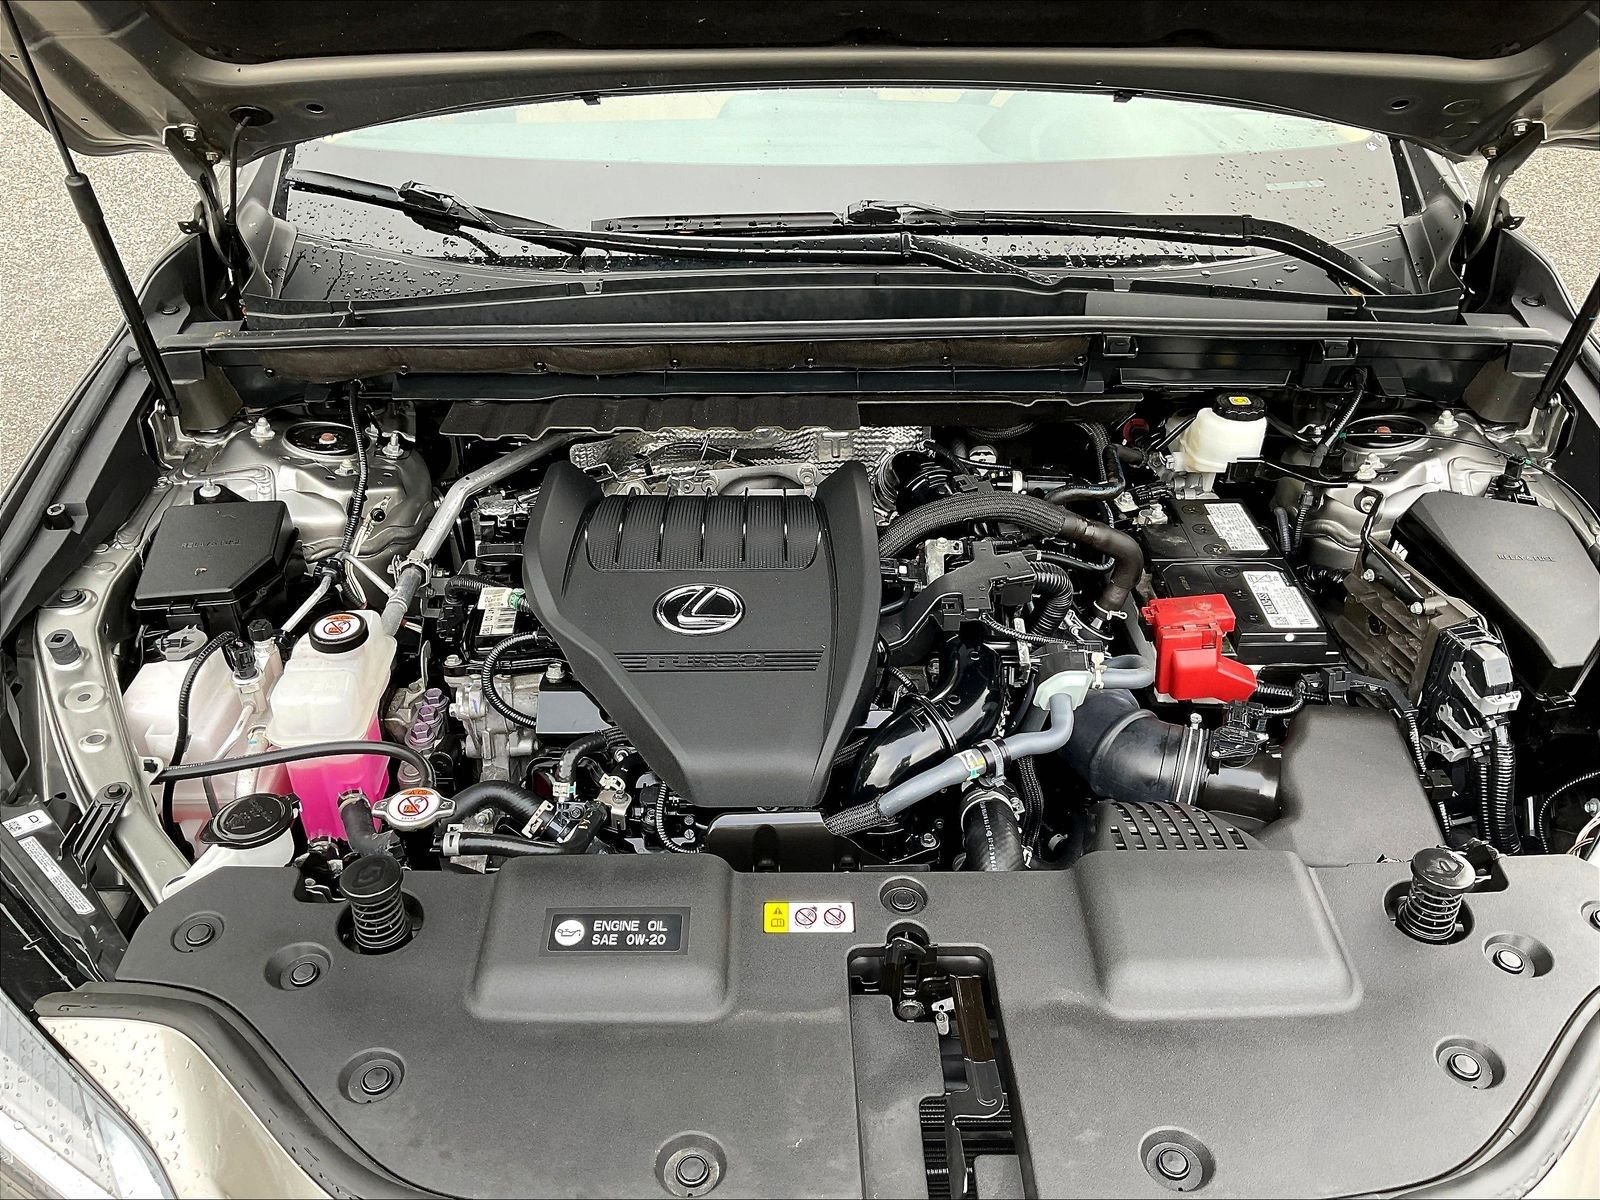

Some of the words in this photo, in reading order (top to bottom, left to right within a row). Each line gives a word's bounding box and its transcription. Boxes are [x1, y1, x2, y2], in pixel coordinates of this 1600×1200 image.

[27, 814, 40, 824] D
[593, 920, 640, 932] ENGINE
[647, 920, 668, 932] OIL
[591, 933, 619, 946] SAE
[626, 933, 667, 946] 0W-20
